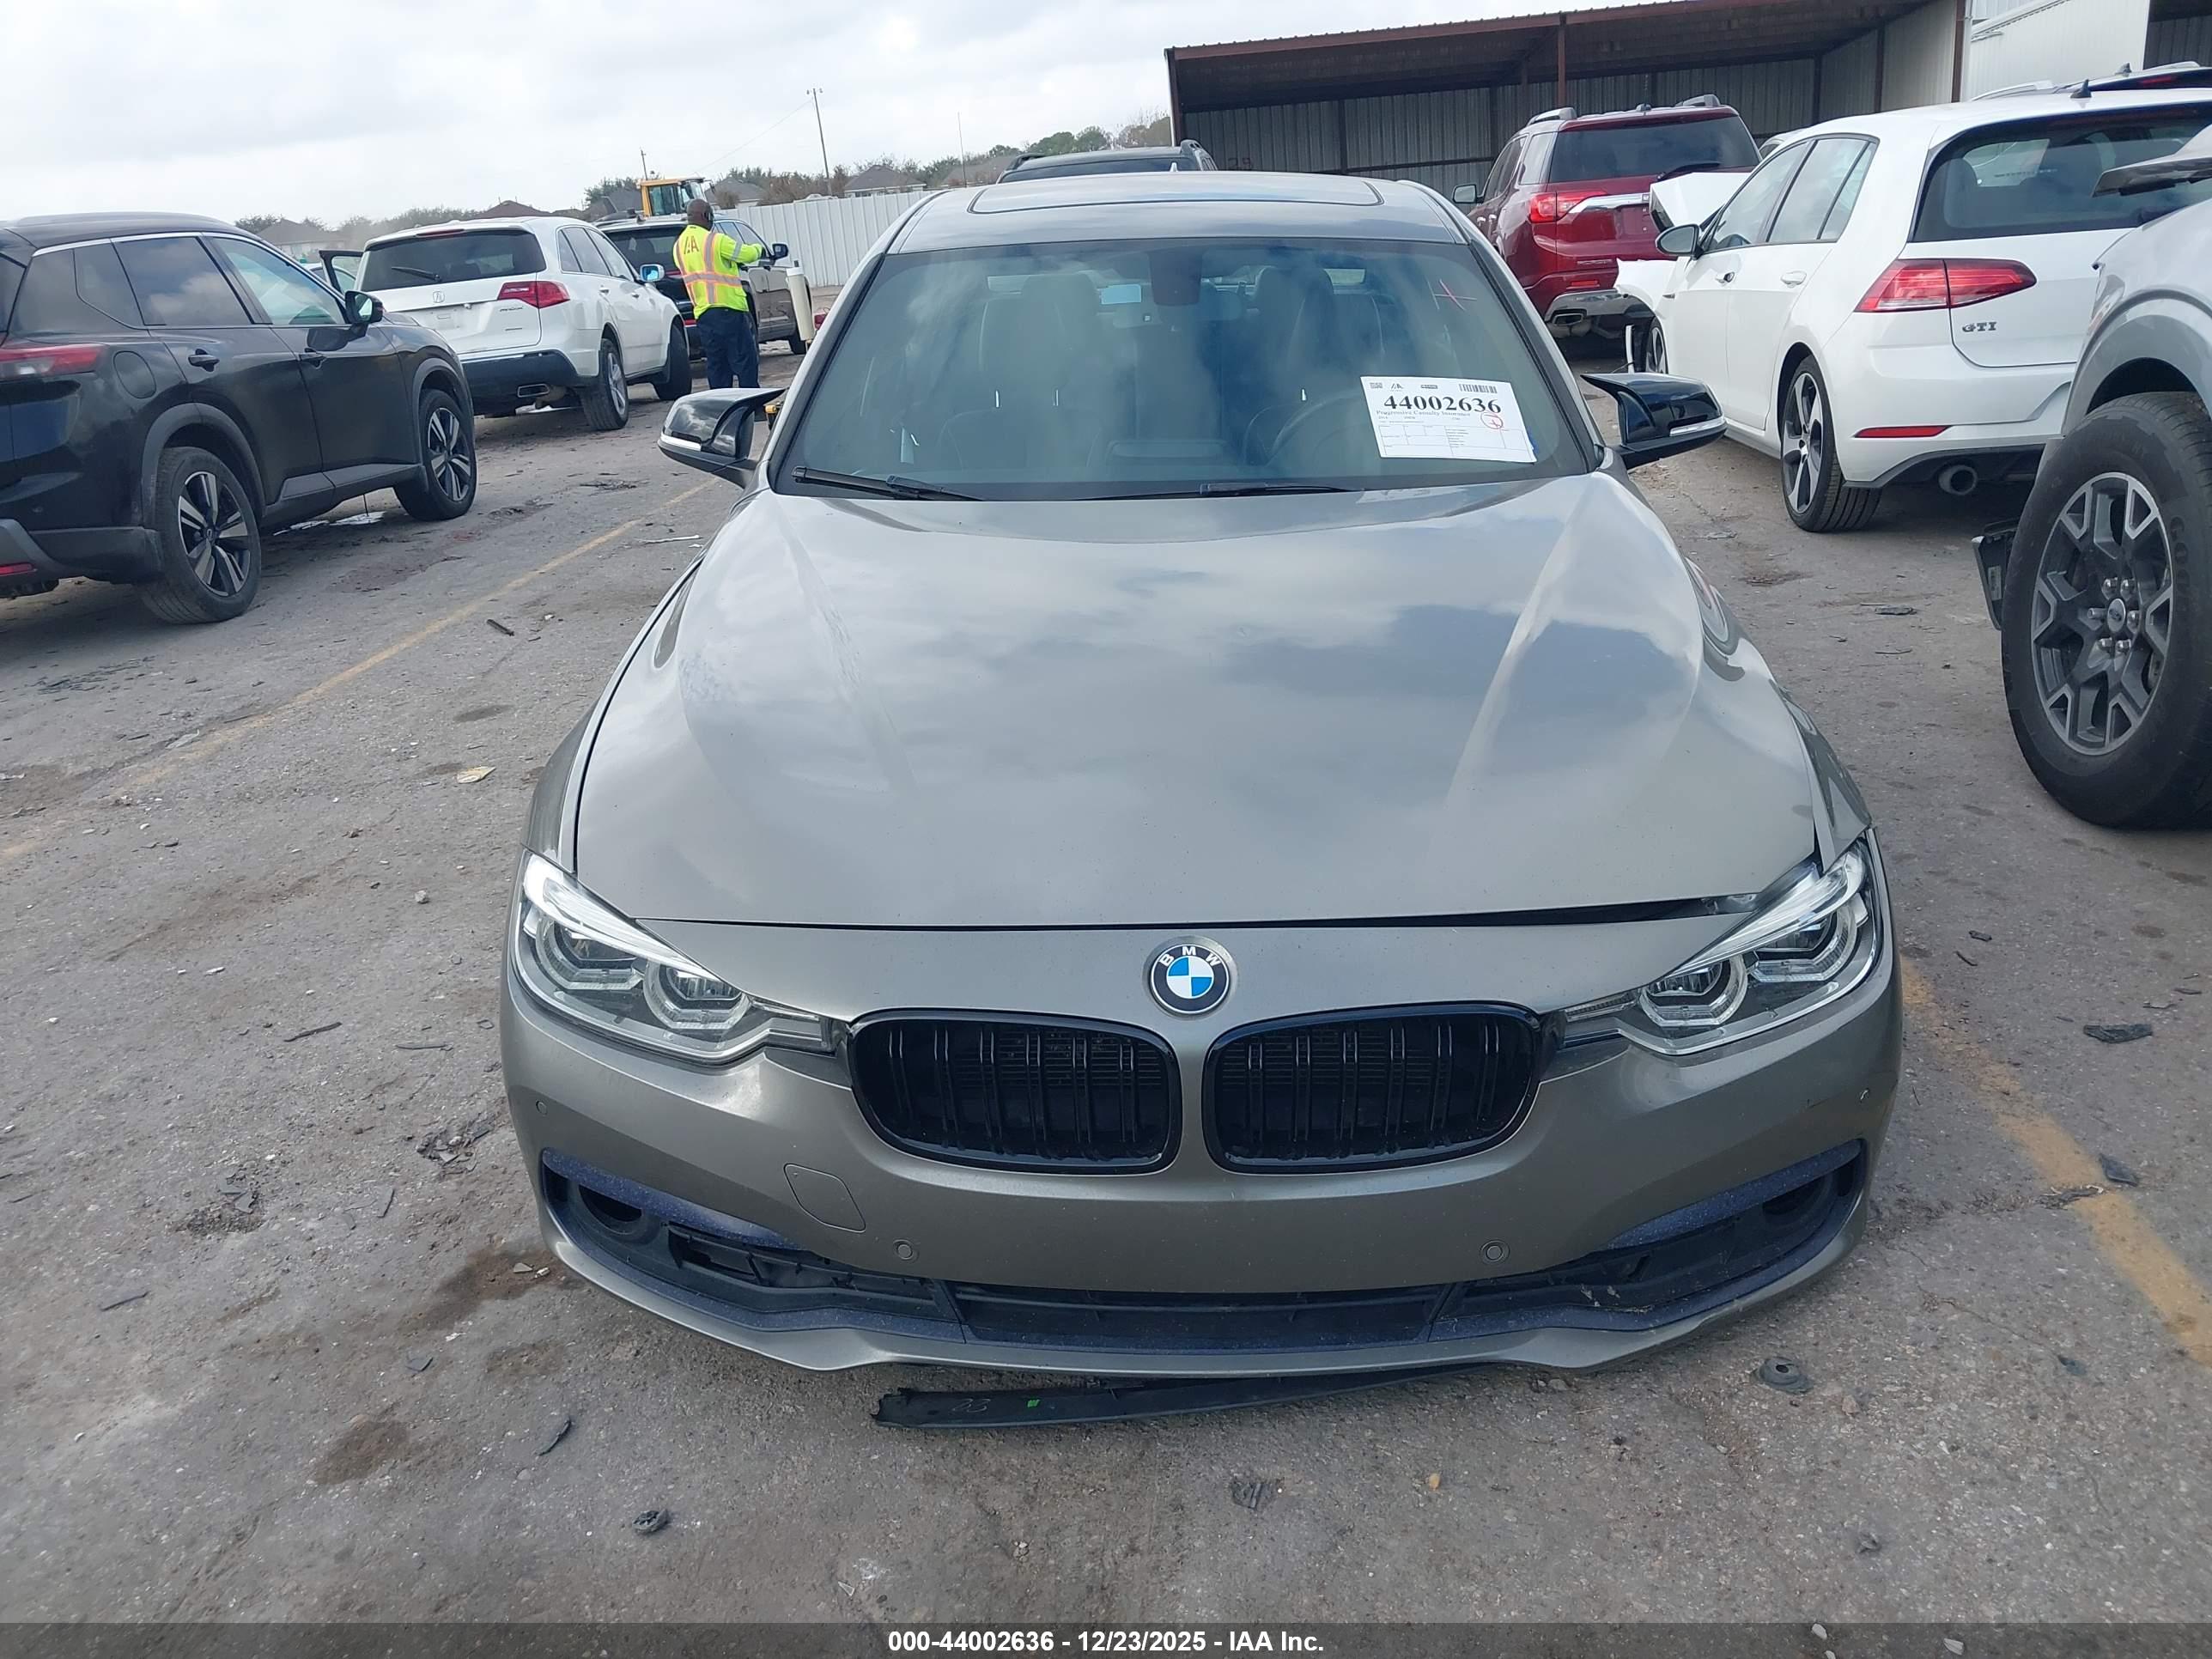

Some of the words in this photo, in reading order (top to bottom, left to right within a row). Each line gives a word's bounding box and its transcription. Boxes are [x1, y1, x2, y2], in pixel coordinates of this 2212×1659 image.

[1962, 321, 1997, 332] GTI
[1383, 395, 1502, 413] 44002636
[1159, 946, 1222, 967] BMW
